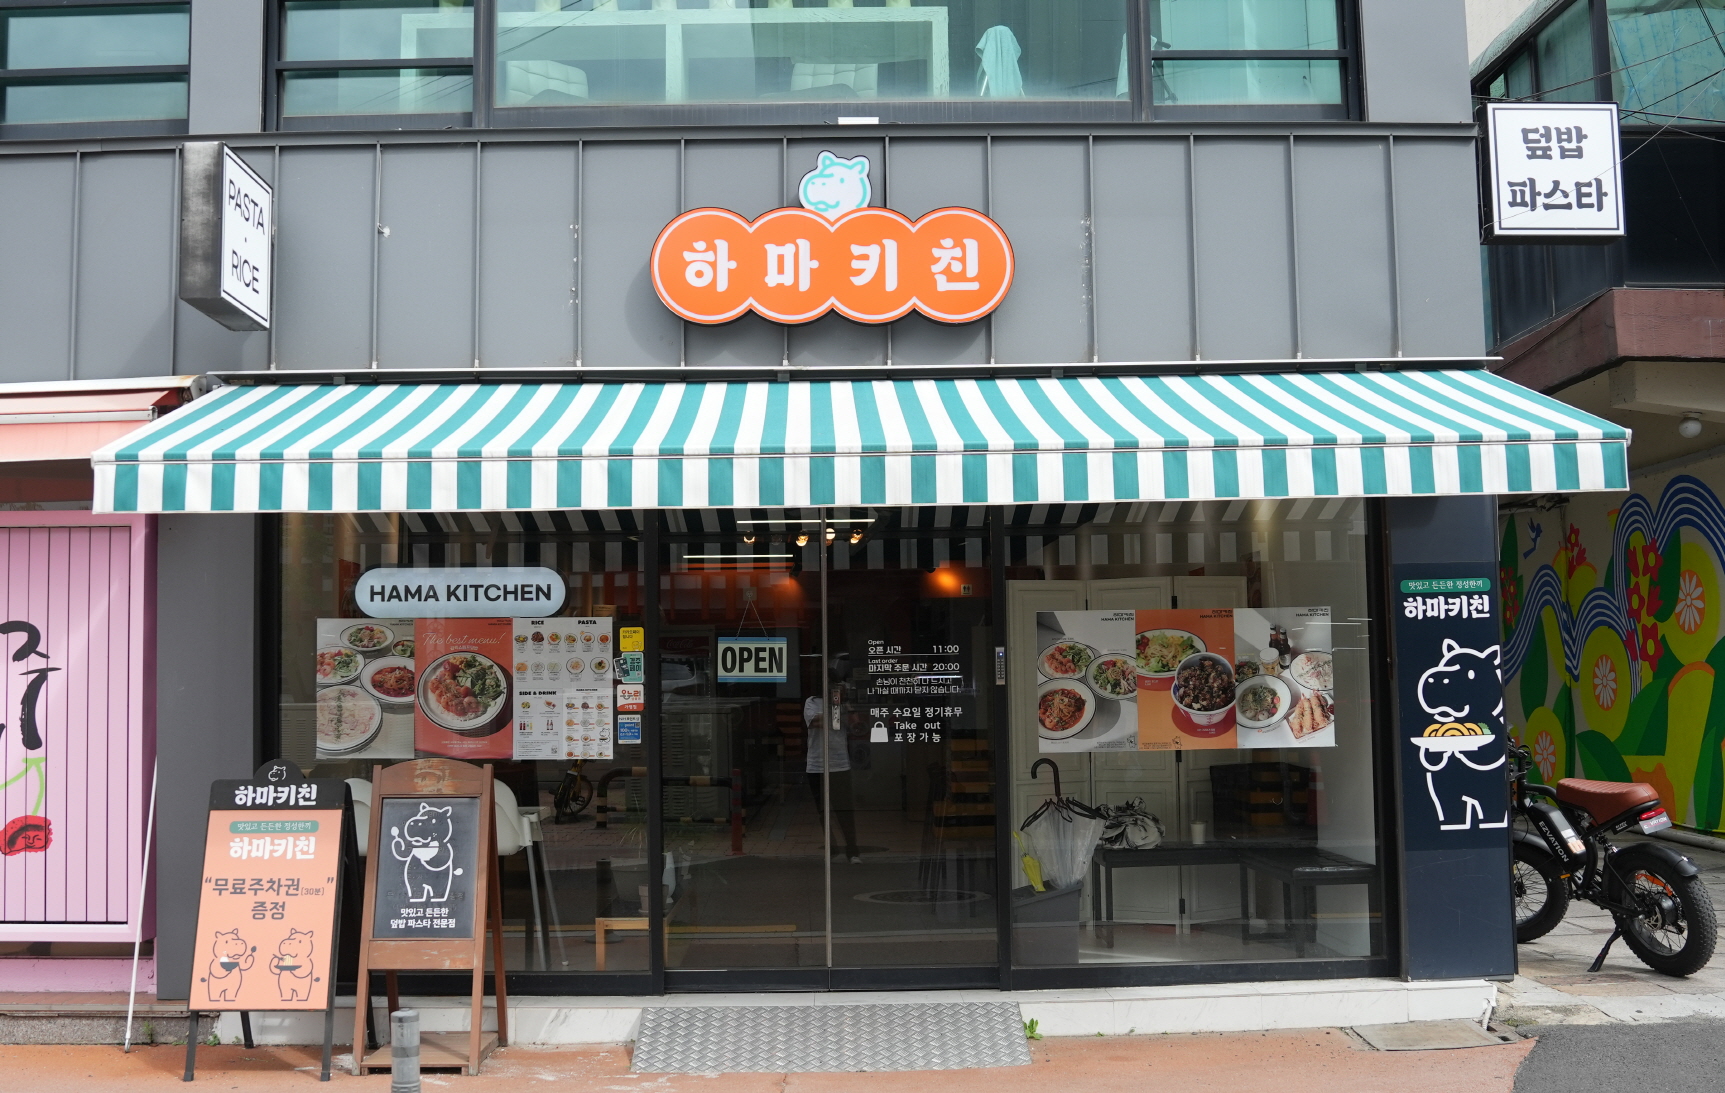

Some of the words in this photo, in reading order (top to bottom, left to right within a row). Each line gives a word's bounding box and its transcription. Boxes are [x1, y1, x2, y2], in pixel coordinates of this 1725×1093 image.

[1521, 126, 1588, 160] 덮밥
[1507, 177, 1609, 213] 파스타
[228, 178, 266, 236] PASTA
[231, 248, 260, 295] RICE
[682, 237, 980, 292] 하마키친
[369, 584, 440, 603] HAMA
[446, 583, 552, 602] KITCHEN
[1408, 581, 1430, 590] 맛있고
[1432, 580, 1454, 590] 든든한
[1456, 579, 1483, 590] 정성한끼
[1403, 594, 1490, 620] 하마키친
[422, 632, 444, 646] The
[445, 632, 468, 646] best
[468, 632, 507, 645] menu!
[868, 646, 884, 655] 오픈
[886, 646, 902, 654] 시간
[932, 645, 960, 653] 11:00
[722, 646, 784, 674] OPEN
[868, 664, 892, 672] 마지막
[894, 663, 910, 672] 주문
[912, 663, 928, 672] 시간
[932, 663, 960, 671] 20:00
[876, 678, 898, 686] 손님이
[914, 686, 929, 694] 닫지
[930, 685, 962, 694] 않습니다.
[870, 708, 890, 718] 매주
[892, 707, 921, 718] 수요일
[924, 706, 963, 718] 정기휴무
[894, 721, 917, 730] Take
[924, 722, 941, 730] out
[234, 783, 318, 807] 하마키친
[237, 822, 258, 831] 맛있고
[260, 822, 282, 831] 든든한
[284, 821, 312, 830] 정성한끼
[230, 836, 316, 860] 하마키친
[1538, 820, 1570, 862] EZVATION
[252, 902, 286, 920] 증정
[400, 908, 424, 917] 맛있고
[426, 907, 449, 917] 든든한
[390, 919, 406, 929] 덮밥
[407, 919, 431, 929] 파스타
[433, 918, 456, 928] 전문점
